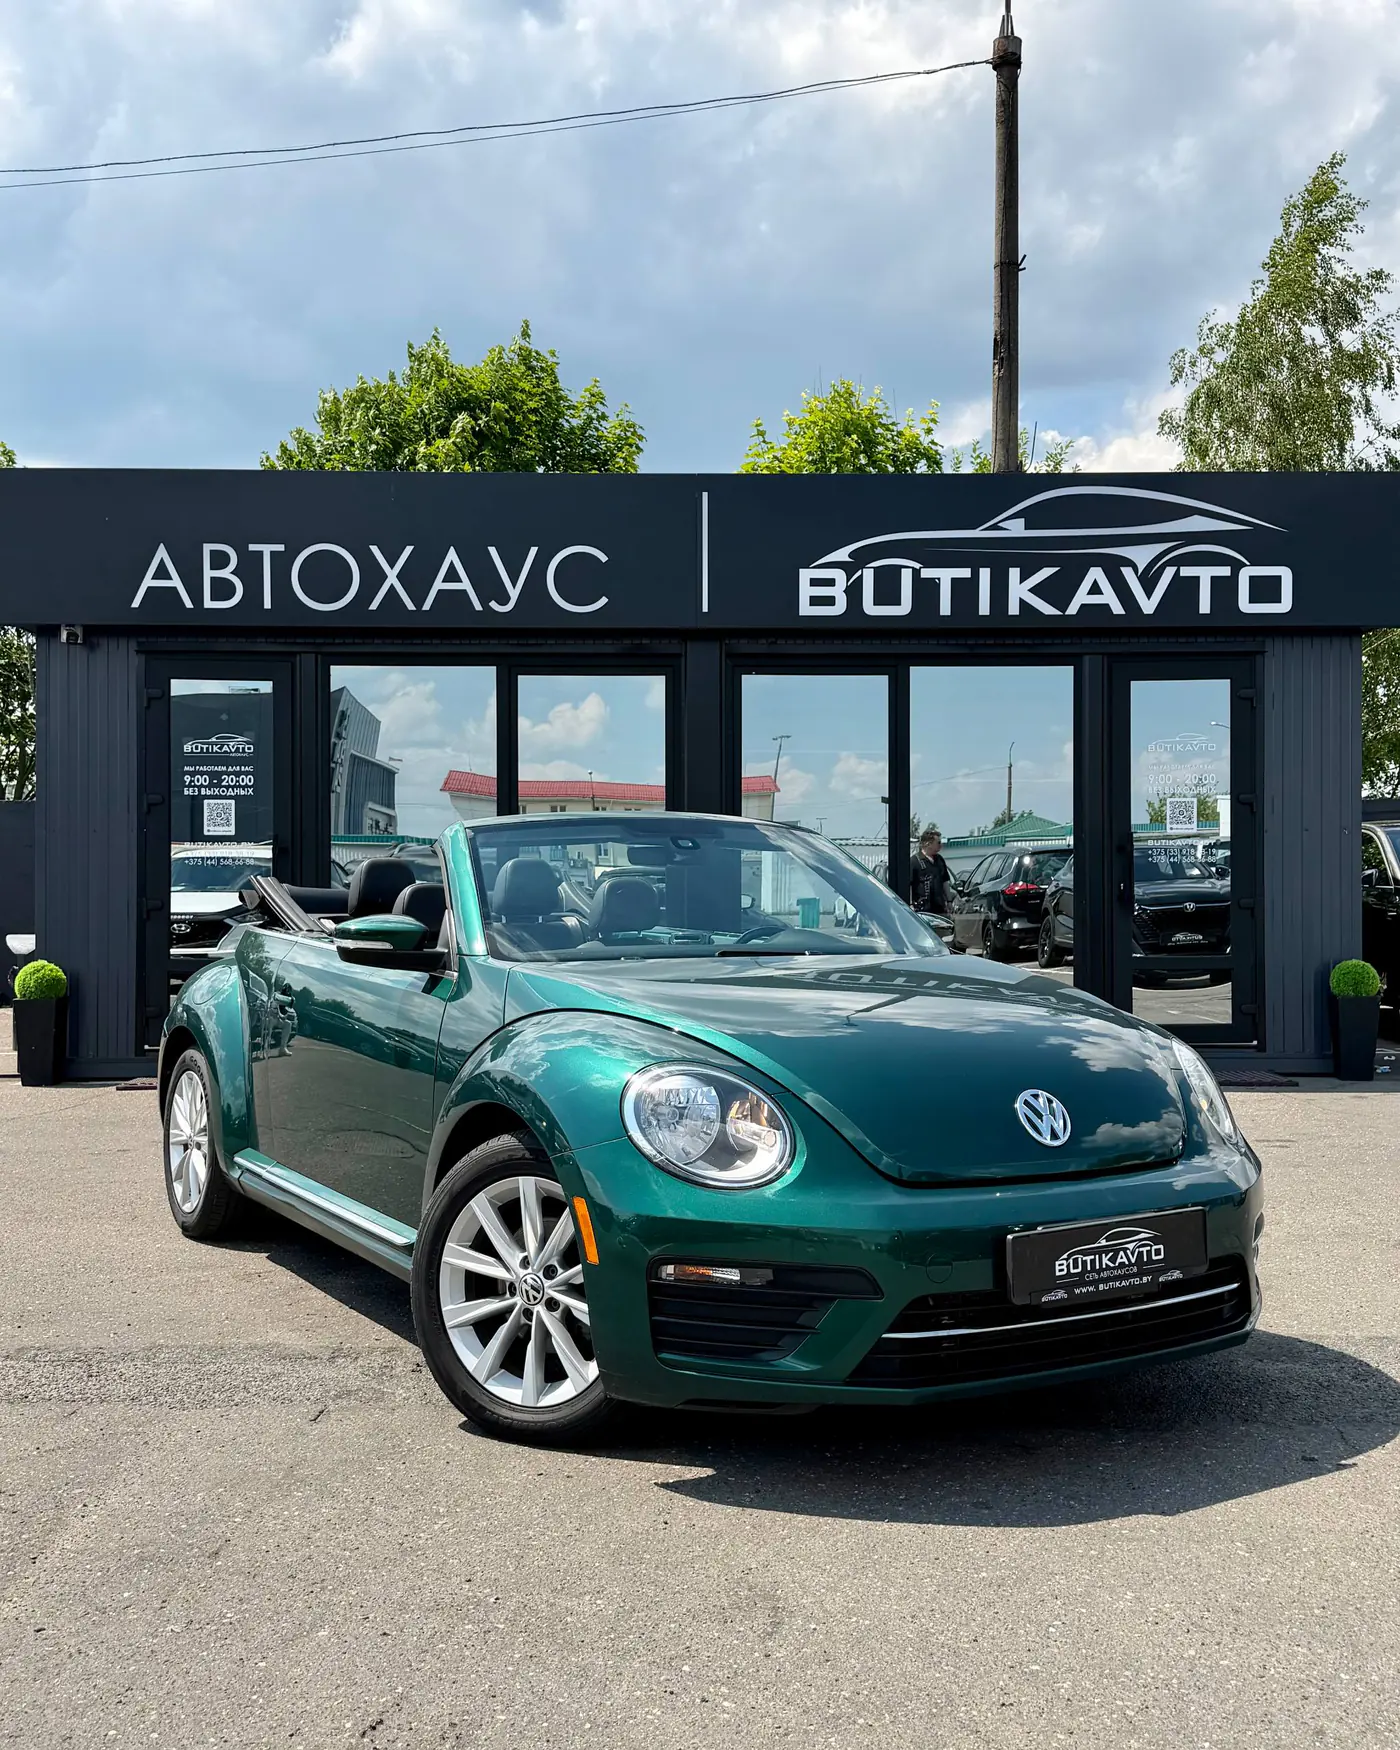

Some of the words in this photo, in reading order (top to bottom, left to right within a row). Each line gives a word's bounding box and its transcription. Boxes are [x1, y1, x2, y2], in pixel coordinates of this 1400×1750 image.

[131, 542, 609, 614] АВТОХАУС
[799, 564, 1293, 616] BUTIKAVTO
[184, 744, 254, 752] BUTIKAVTO
[1148, 743, 1216, 752] BUTIKAVTO
[184, 775, 209, 786] 9:00
[221, 775, 254, 786] 20:00
[1148, 774, 1173, 784] 9:00
[1184, 773, 1216, 784] 20:00
[184, 787, 199, 796] БЕЗ
[200, 787, 254, 797] ВЫХОДНЫХ
[184, 858, 202, 866] +375
[203, 857, 218, 867] (44)
[1055, 1244, 1165, 1276] BUTIKAVTO
[1085, 1272, 1099, 1280] СЕТЬ
[1100, 1266, 1138, 1278] АВТОХАУСОВ
[1098, 1275, 1153, 1291] BUTIKAVTO.BY
